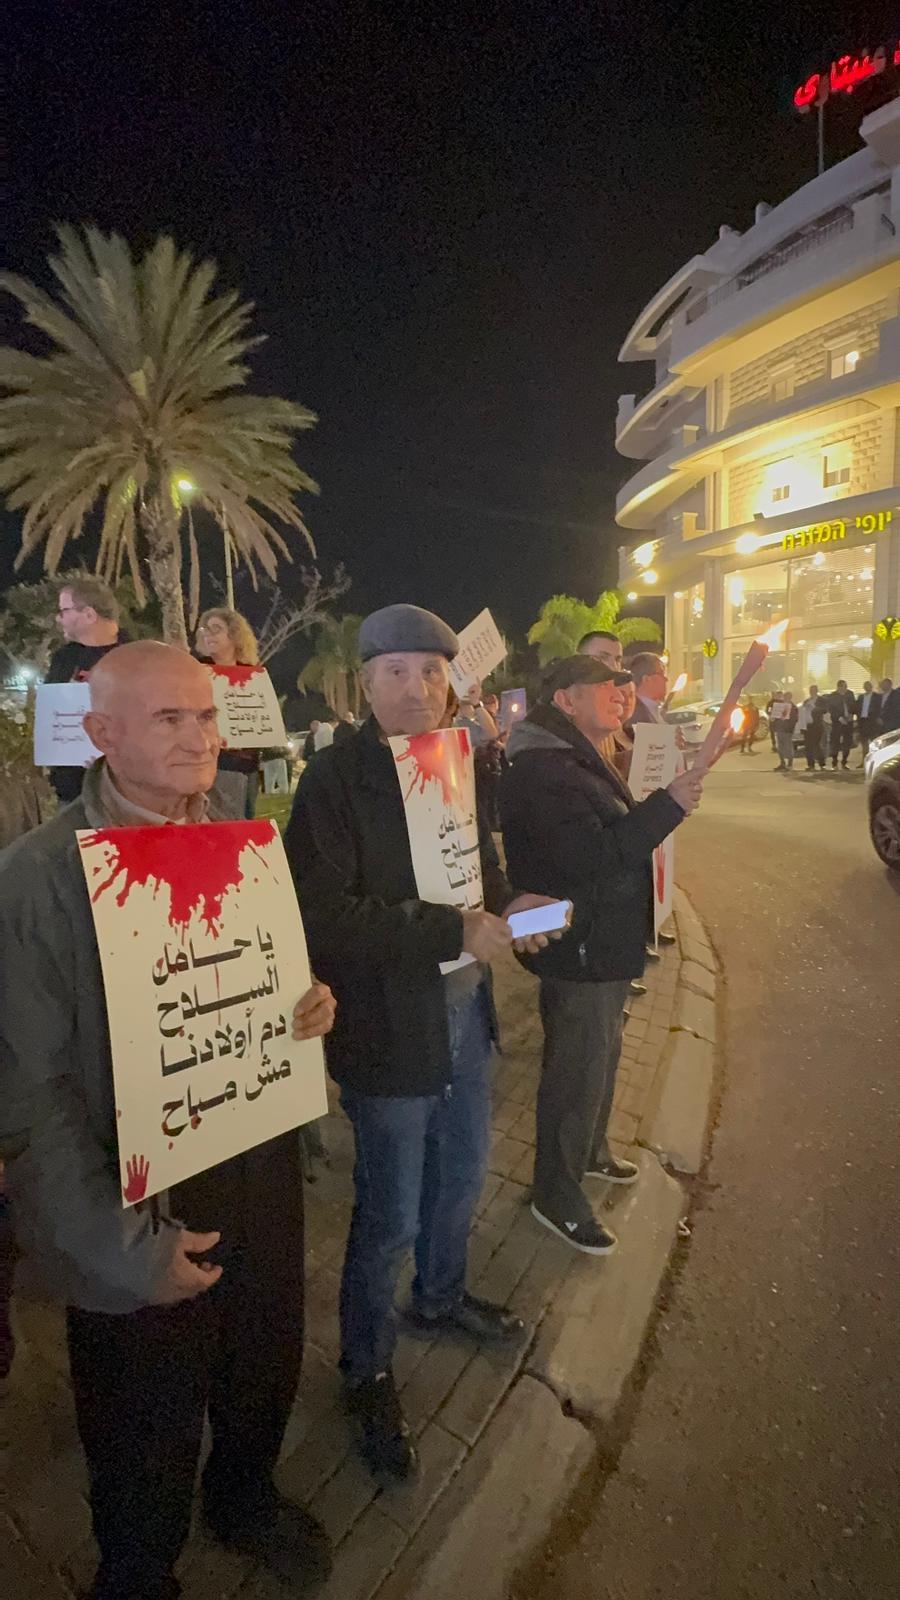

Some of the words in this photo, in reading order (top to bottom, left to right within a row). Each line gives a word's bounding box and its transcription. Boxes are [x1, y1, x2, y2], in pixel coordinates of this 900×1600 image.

[781, 519, 847, 552] המזרח
[855, 510, 892, 534] יופי
[152, 937, 252, 986] حامل
[256, 924, 275, 960] يا
[157, 964, 280, 1038] السلاح
[160, 1007, 255, 1077] أولادنا
[260, 1013, 287, 1056] دم
[245, 1054, 292, 1102] مش
[162, 1080, 238, 1137] مباح
